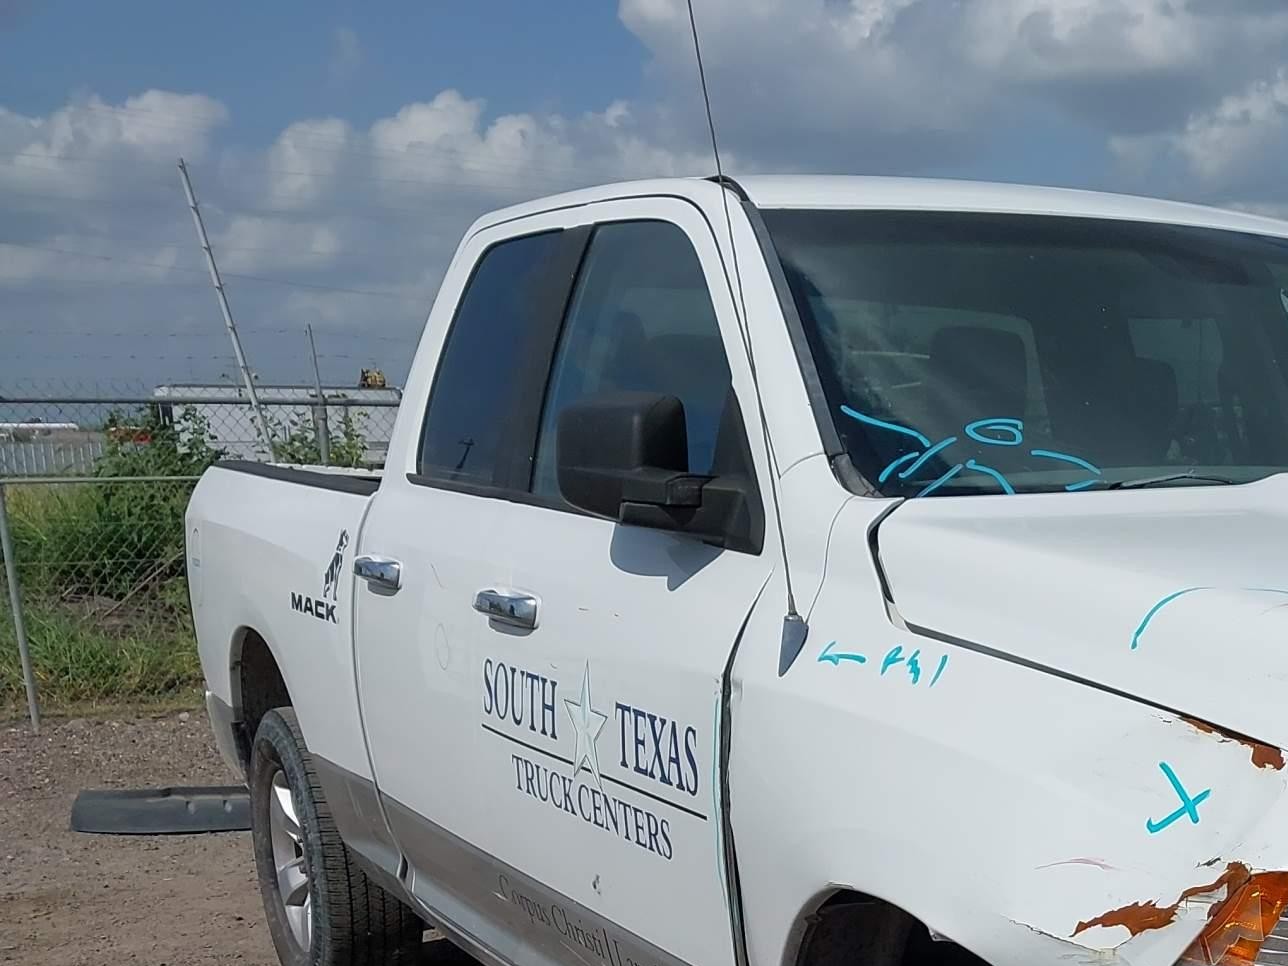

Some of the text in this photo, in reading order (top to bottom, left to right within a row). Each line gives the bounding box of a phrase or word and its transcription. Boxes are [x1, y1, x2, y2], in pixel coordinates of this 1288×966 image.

[290, 591, 338, 624] MACK
[483, 658, 699, 797] SOUTH TEXAS
[511, 753, 673, 860] TRUCK CENTERS
[496, 874, 551, 927] Corpus
[551, 903, 606, 960] Christi
